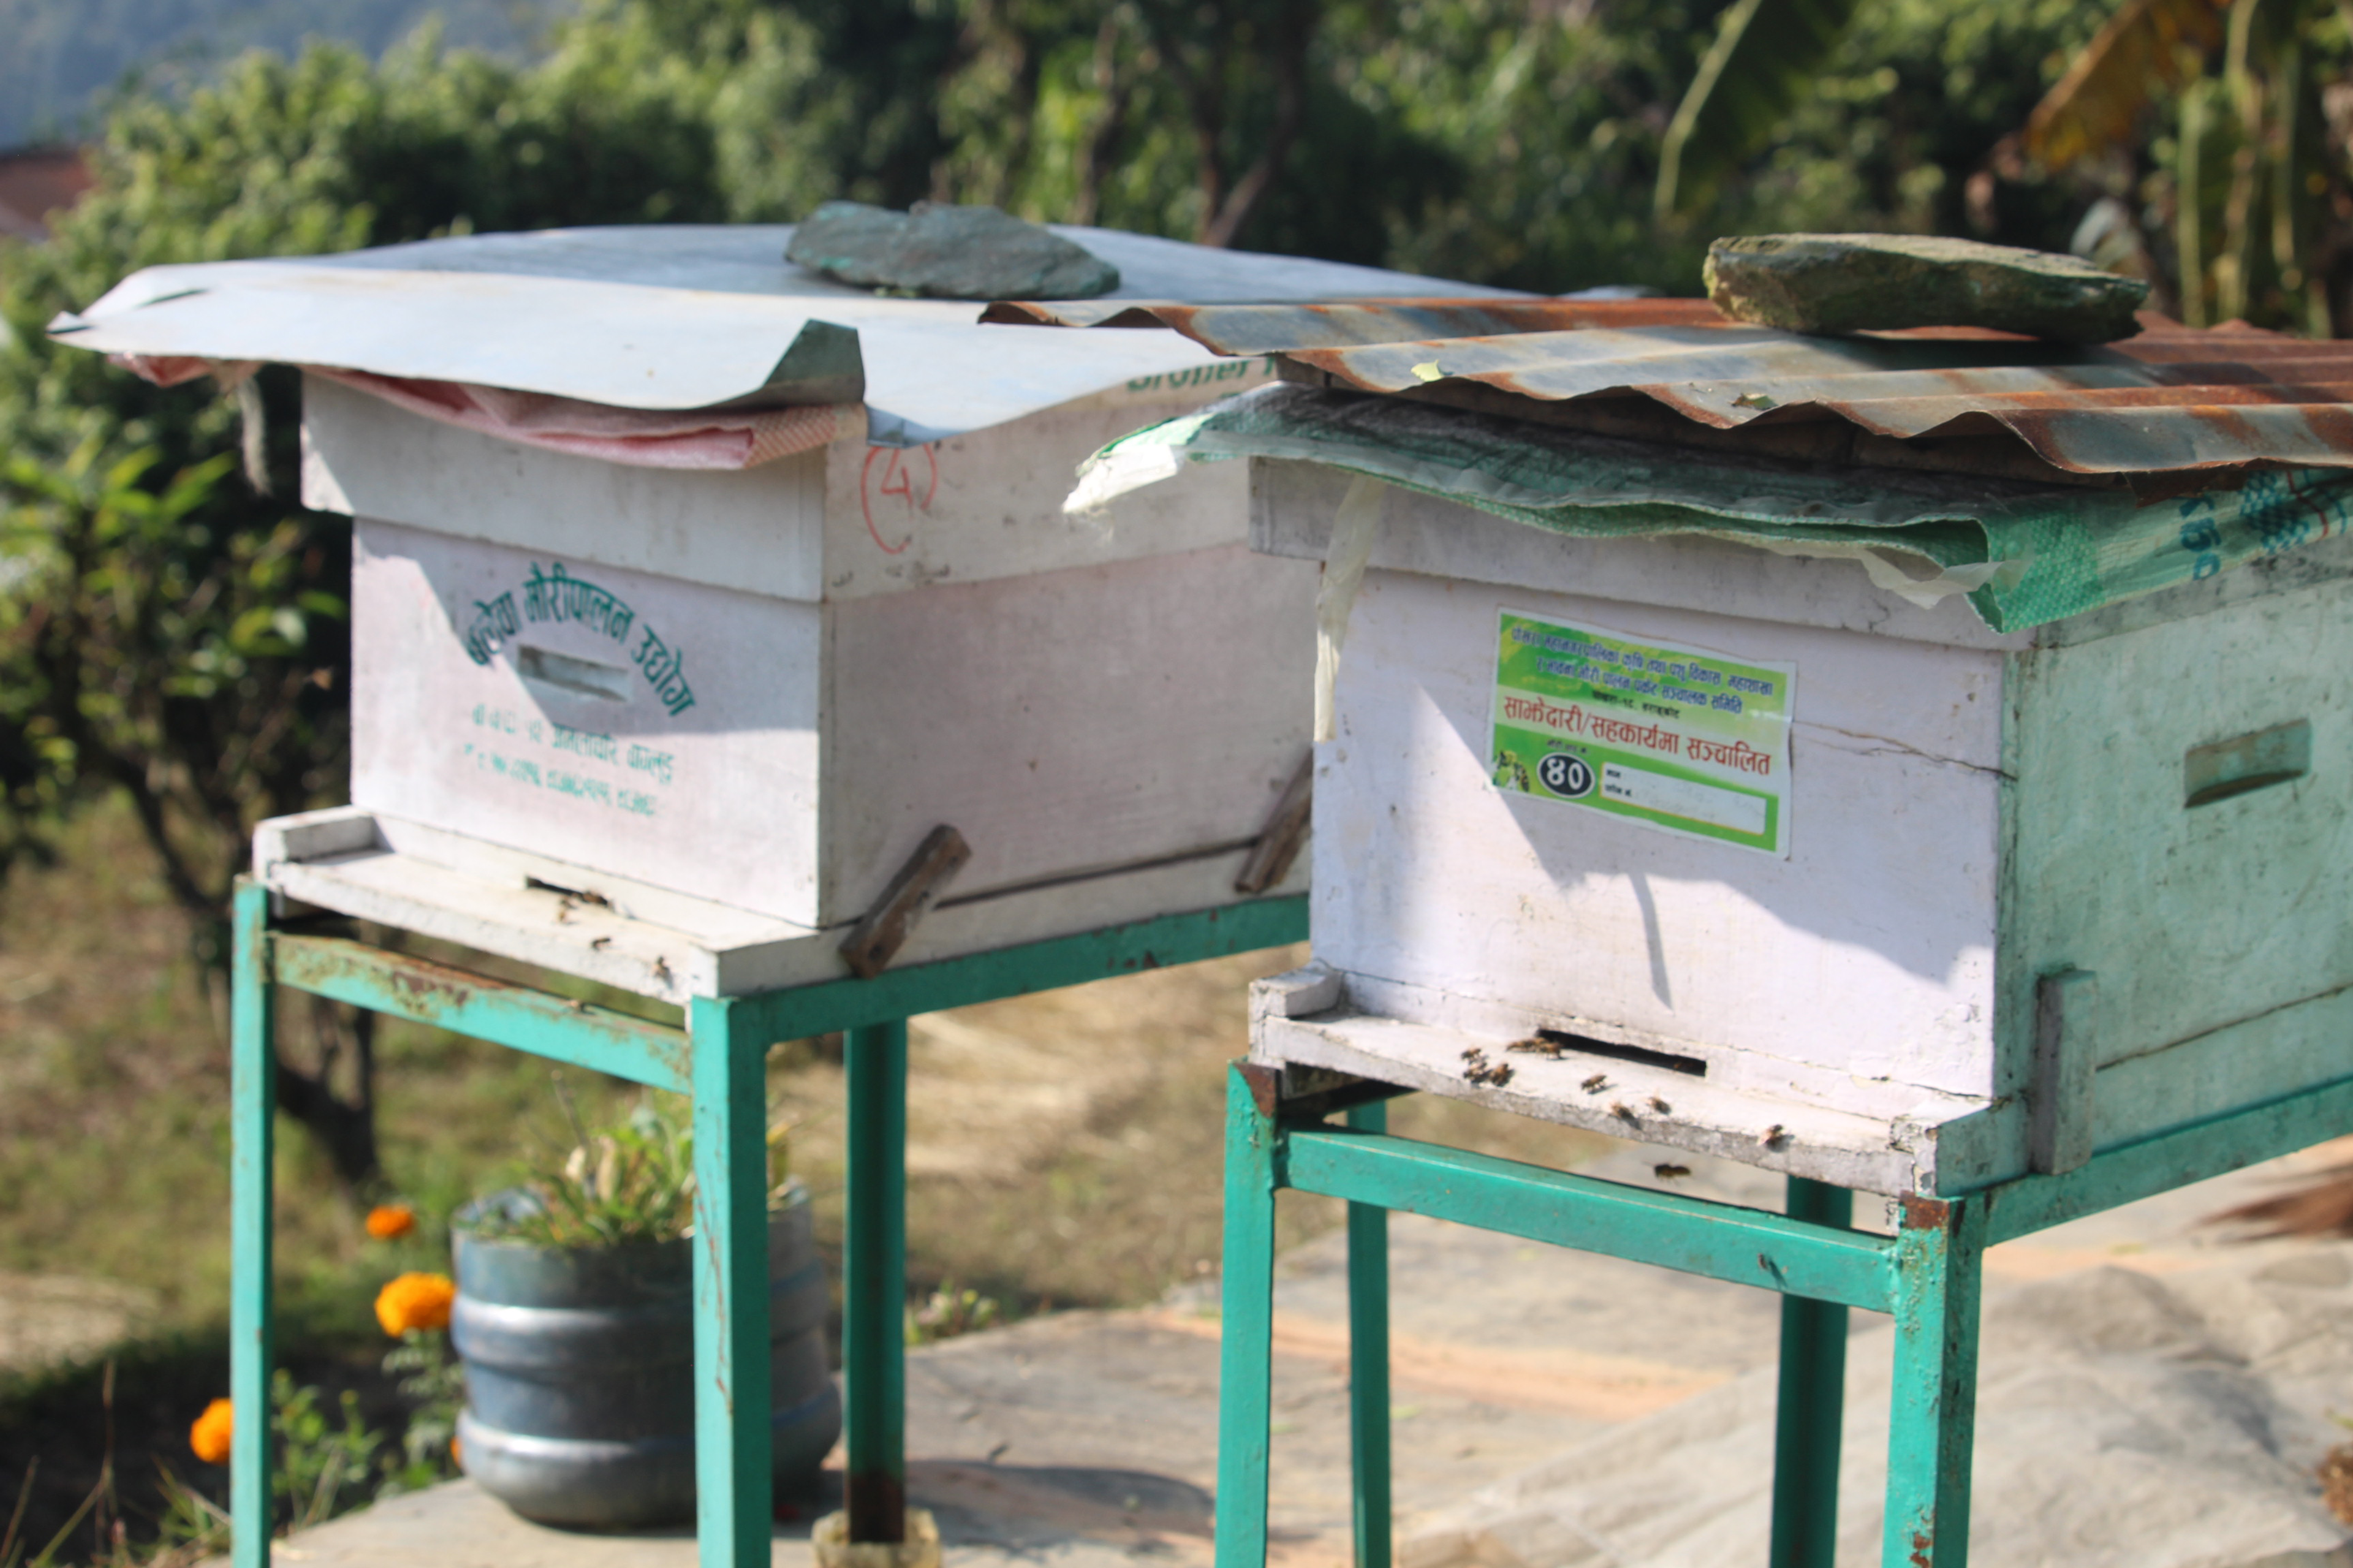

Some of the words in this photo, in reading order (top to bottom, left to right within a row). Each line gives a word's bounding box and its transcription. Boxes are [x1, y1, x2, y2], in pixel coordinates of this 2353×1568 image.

[1512, 627, 1541, 647] पोखरा
[1544, 635, 1620, 664] महानगरपालिका
[1622, 651, 1644, 672] कृषि
[1647, 659, 1666, 674] तथा
[1689, 662, 1721, 686] विकास
[1603, 672, 1631, 690] पालन
[1711, 692, 1743, 714] समिति
[1546, 757, 1585, 790] ४०
[1686, 741, 1770, 775] सञ्चालित
